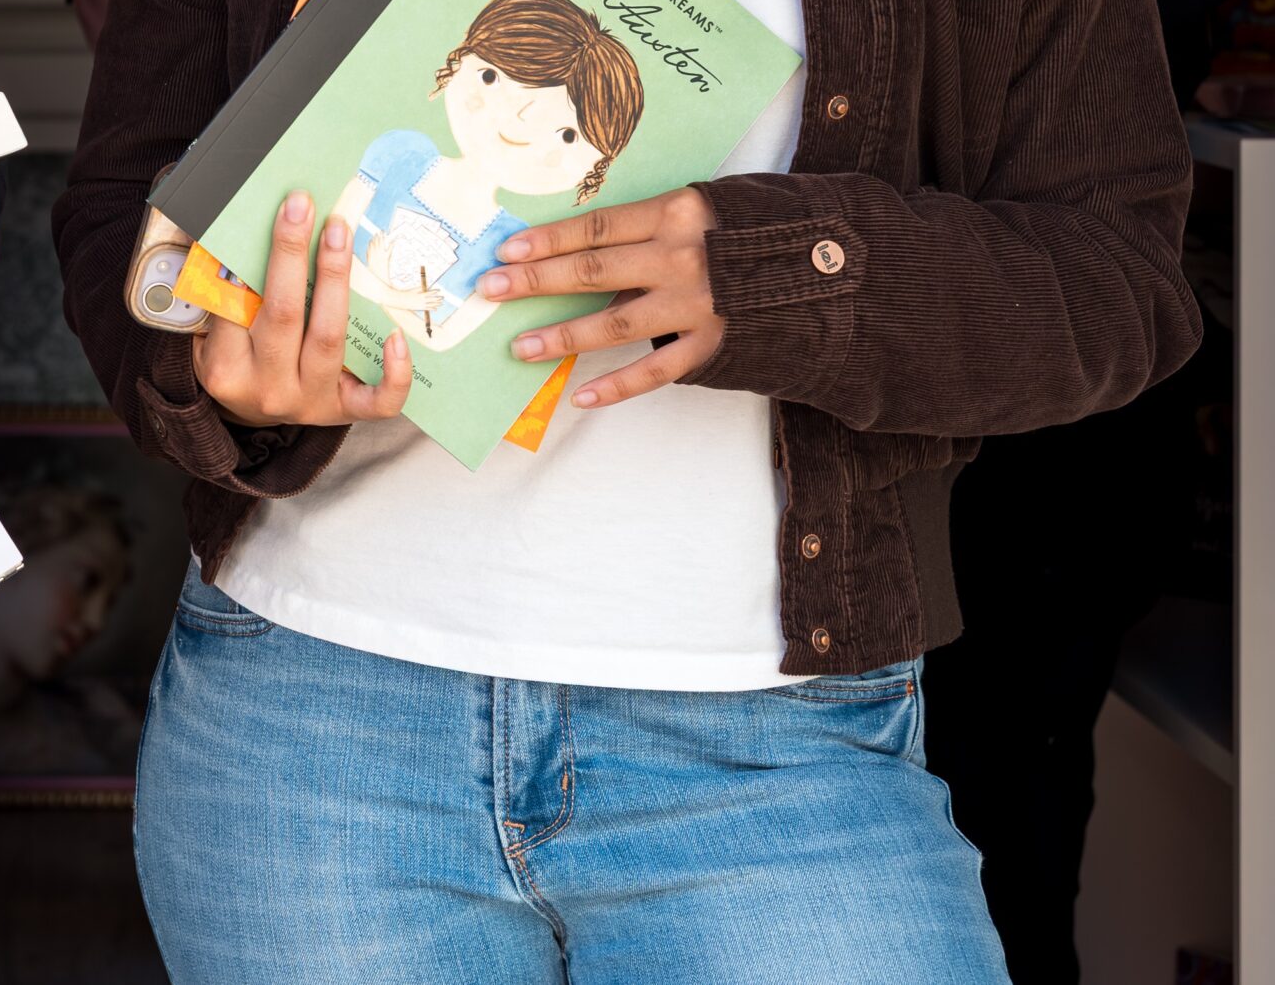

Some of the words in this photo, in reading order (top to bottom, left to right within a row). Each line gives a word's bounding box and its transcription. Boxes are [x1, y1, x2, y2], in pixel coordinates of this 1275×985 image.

[350, 337, 373, 359] Katie
[351, 316, 377, 341] Isabel
[411, 364, 433, 389] egara
